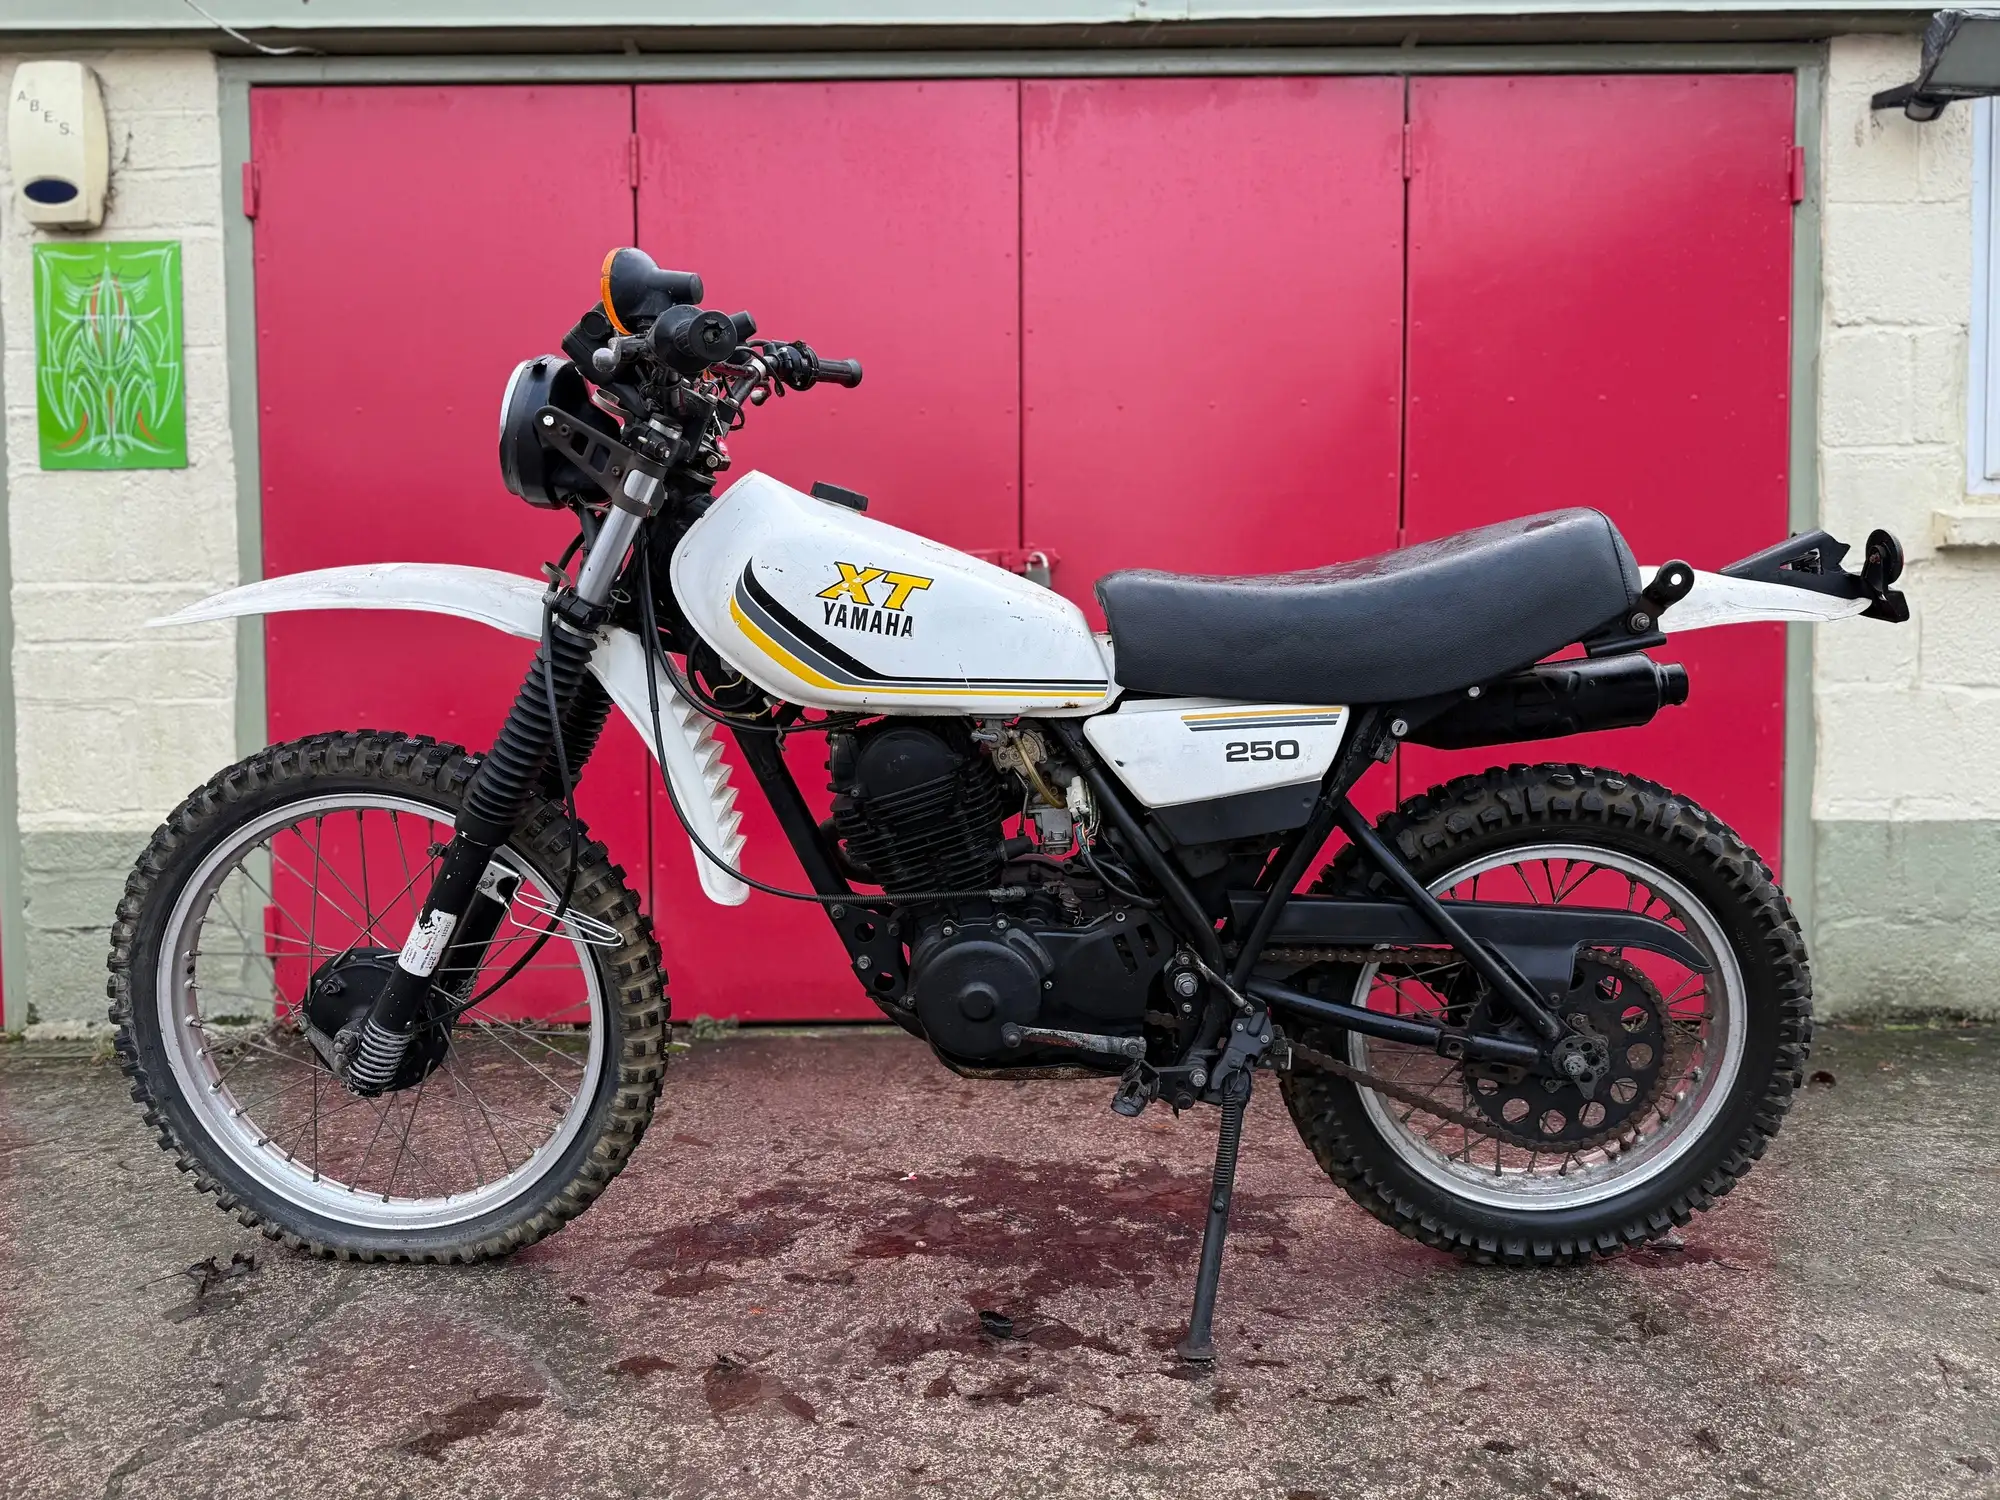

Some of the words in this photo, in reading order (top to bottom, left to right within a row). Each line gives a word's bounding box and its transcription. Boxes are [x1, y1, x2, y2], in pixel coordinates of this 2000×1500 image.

[815, 561, 935, 611] XT
[823, 601, 913, 637] YAMAHA
[1225, 740, 1299, 762] 250
